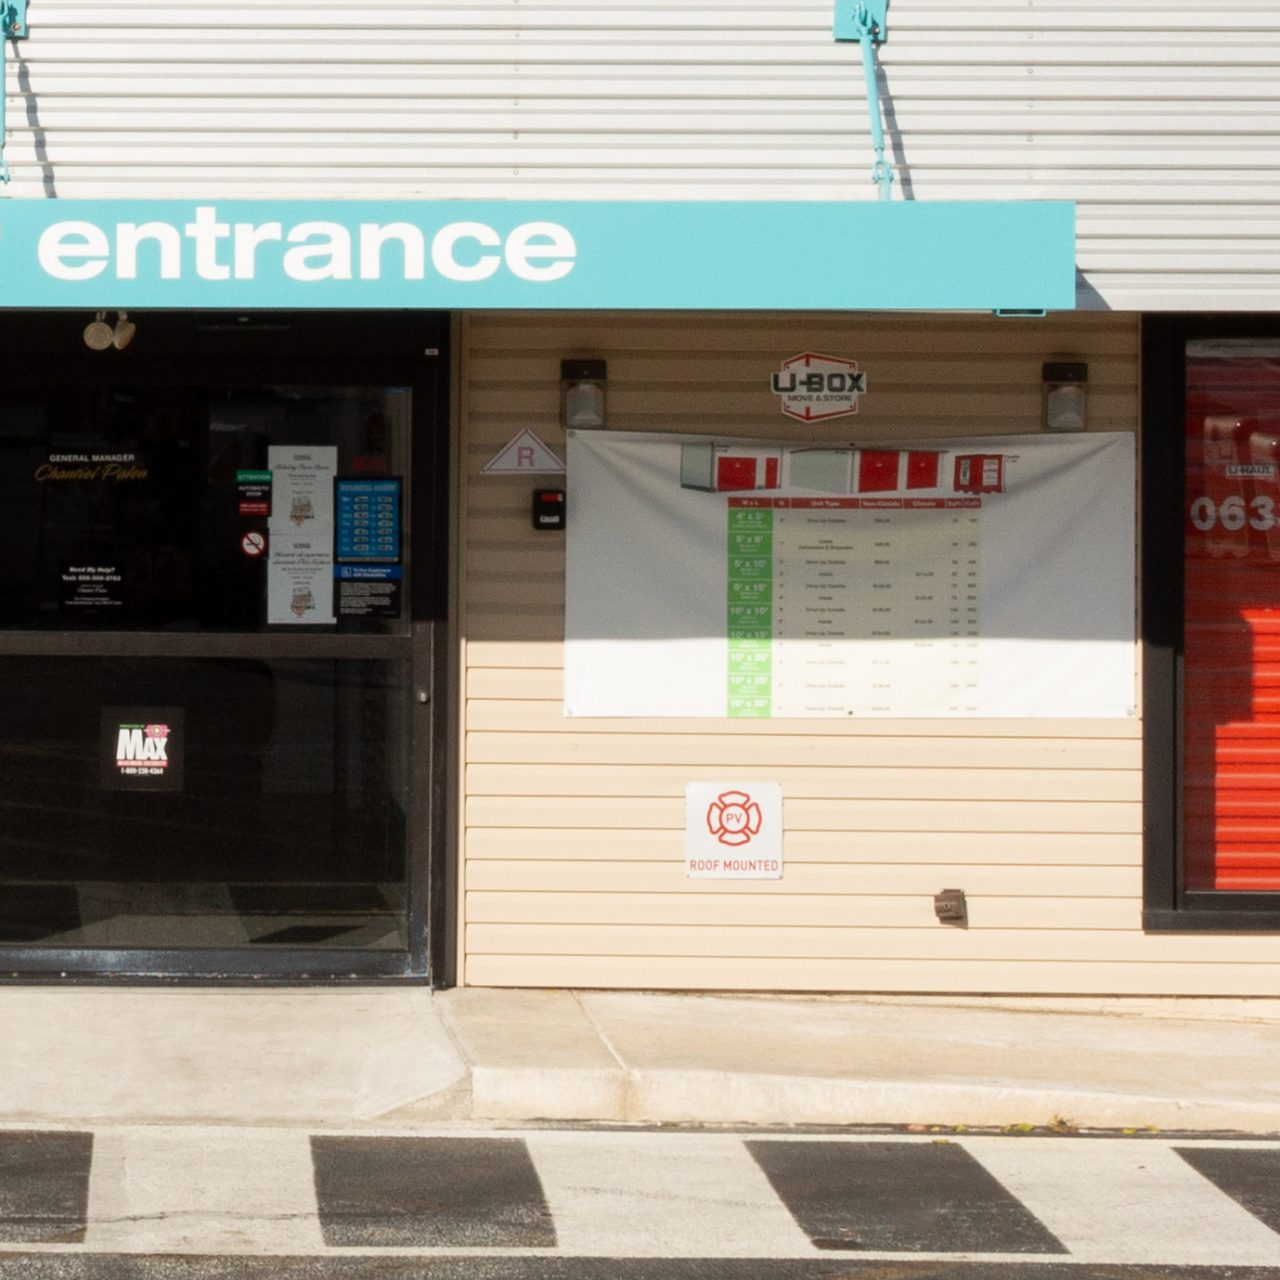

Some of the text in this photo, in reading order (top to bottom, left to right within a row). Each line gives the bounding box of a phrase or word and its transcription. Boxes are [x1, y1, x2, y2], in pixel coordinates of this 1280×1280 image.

[37, 206, 577, 282] entrance
[773, 372, 864, 393] U-BOX
[788, 394, 813, 402] MOVE
[823, 394, 853, 402] STORE
[49, 453, 135, 462] GENERAL MANAGER
[517, 446, 535, 467] R
[1190, 495, 1280, 531] 063
[116, 728, 168, 760] MAX
[726, 813, 742, 824] PV
[689, 859, 779, 871] ROOF MOUNTED
